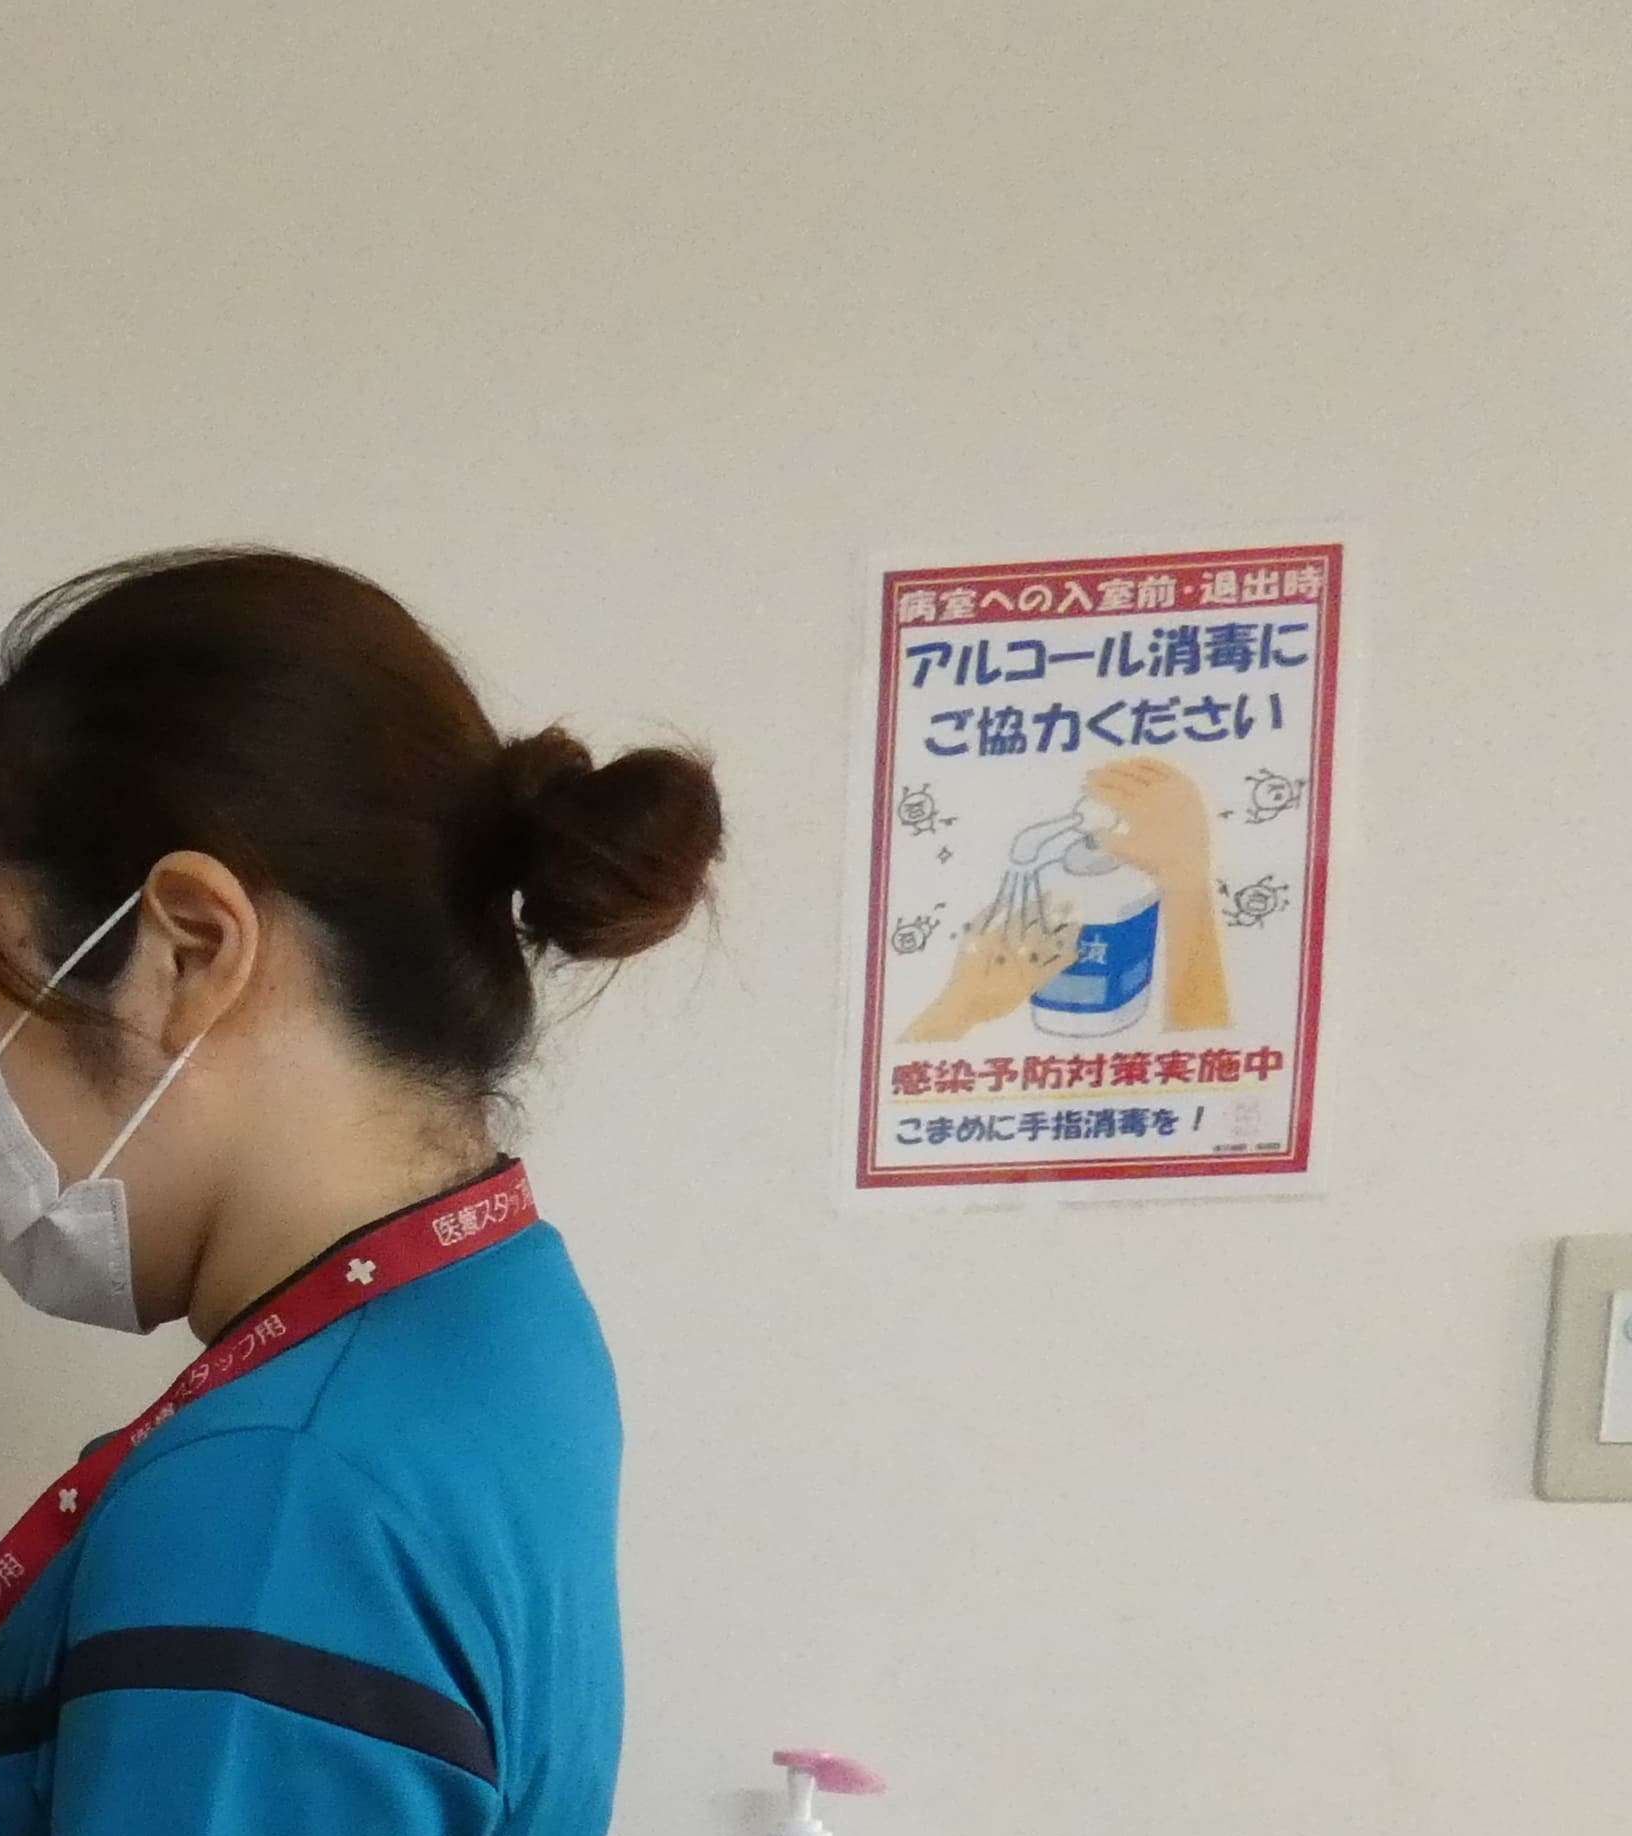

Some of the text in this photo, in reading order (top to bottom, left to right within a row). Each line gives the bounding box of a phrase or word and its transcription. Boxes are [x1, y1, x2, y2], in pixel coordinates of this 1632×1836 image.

[905, 621, 1310, 689] アルコール消毒に
[924, 691, 1284, 757] ご協力ください
[892, 1045, 1285, 1096] 感染予防対策実施中
